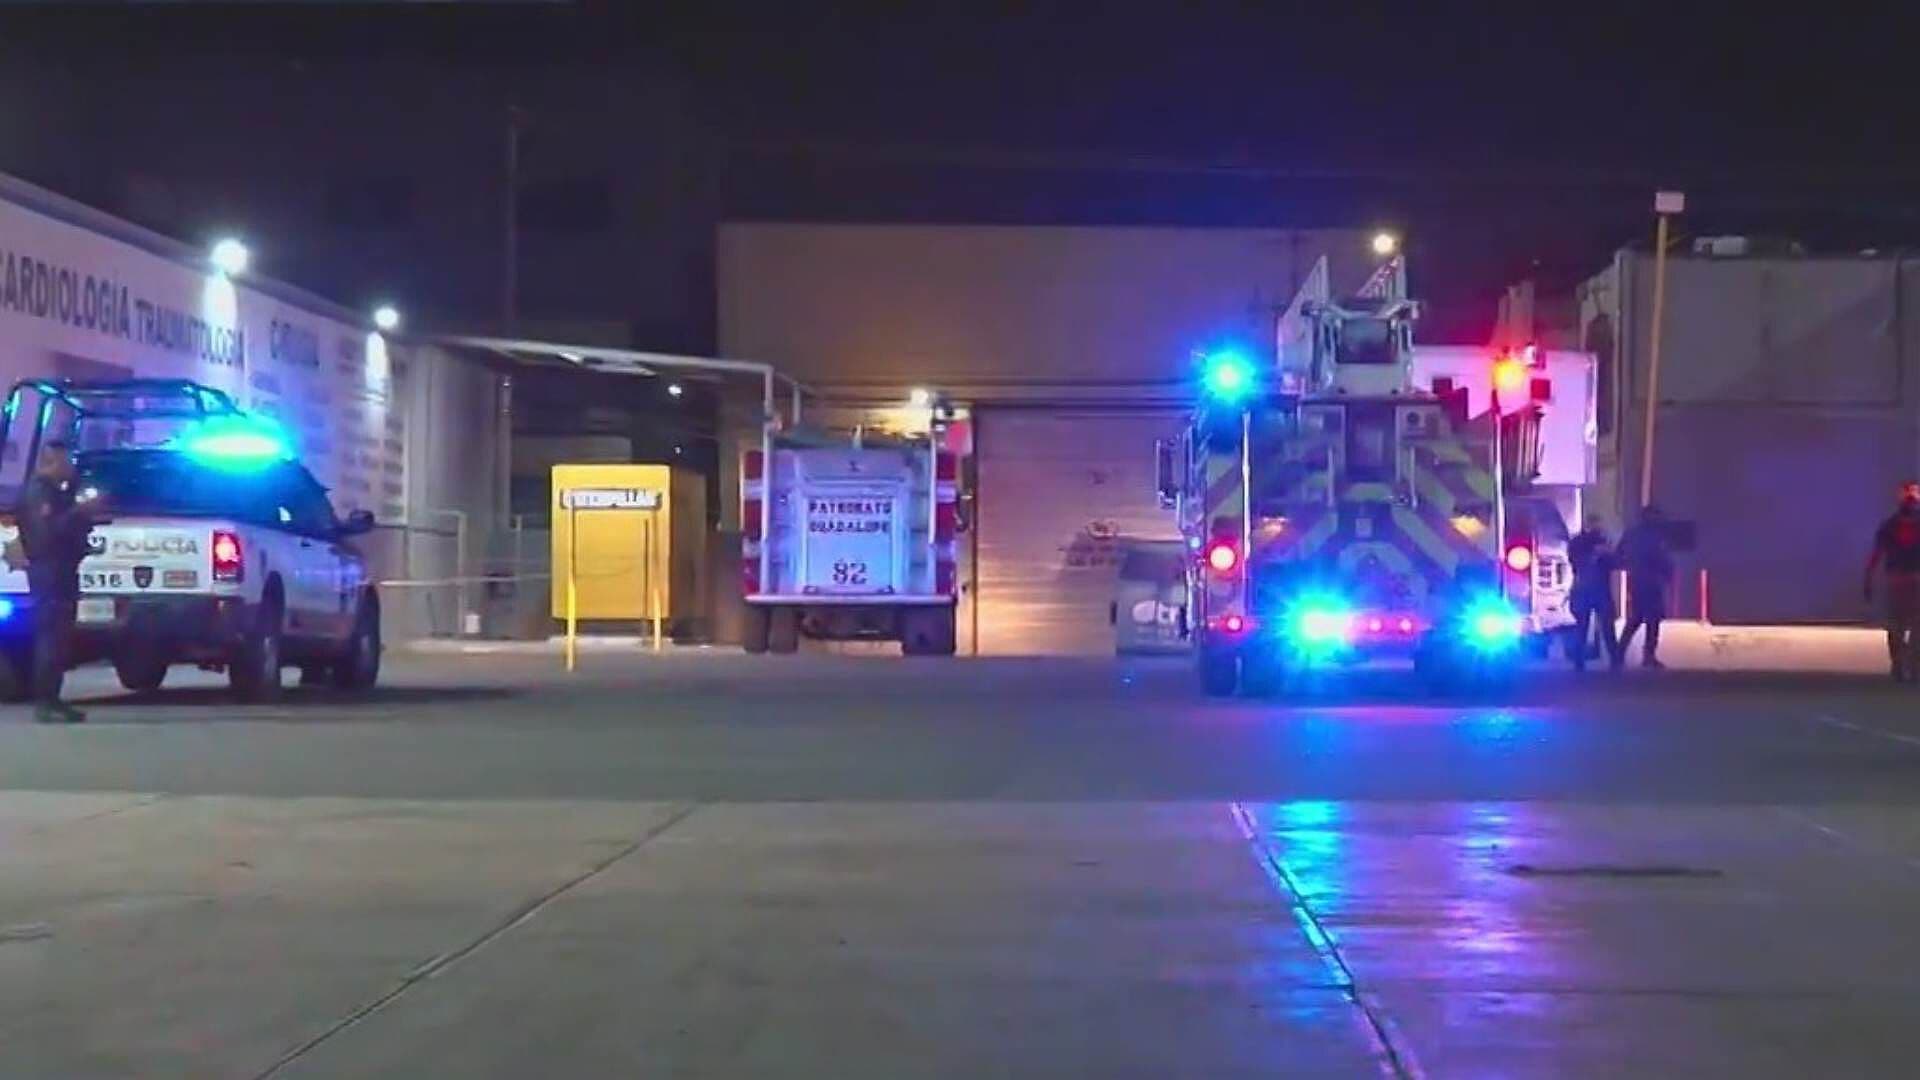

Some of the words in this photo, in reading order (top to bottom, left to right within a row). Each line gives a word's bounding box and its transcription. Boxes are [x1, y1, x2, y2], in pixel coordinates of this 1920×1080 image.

[0, 250, 130, 340] ARDIOLOGÍA
[809, 520, 889, 533] GUADALUPE
[832, 561, 867, 585] 82
